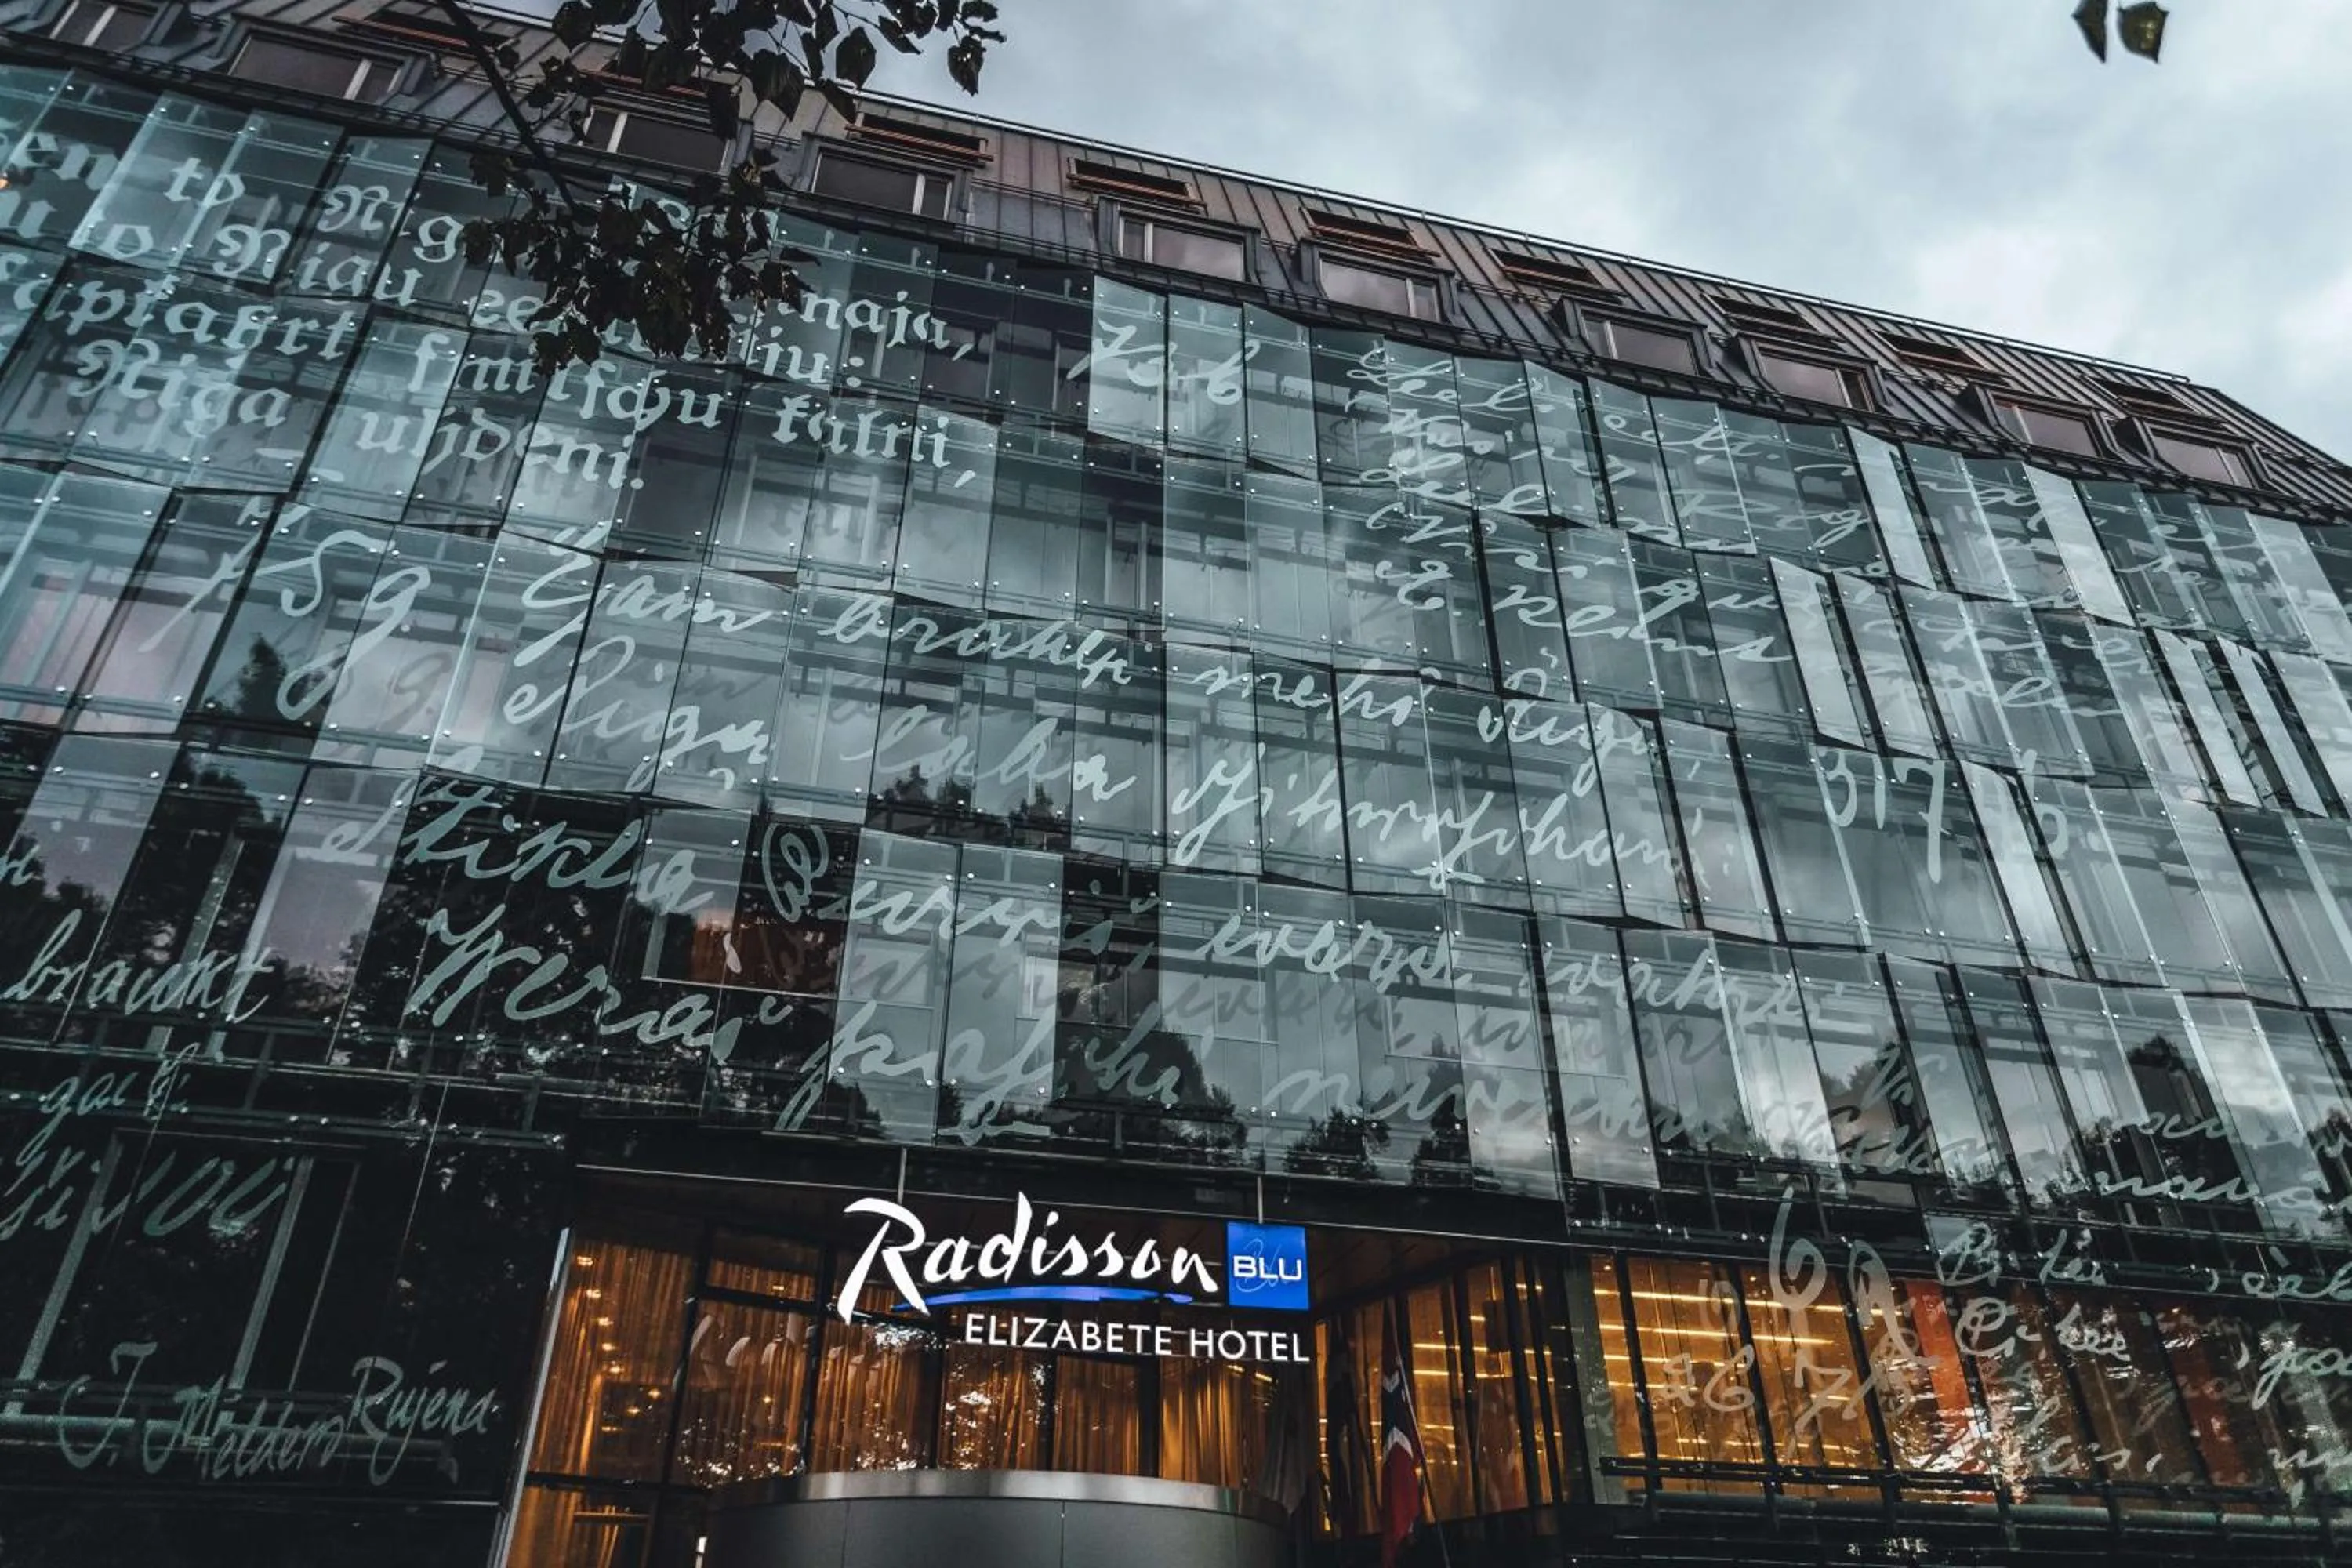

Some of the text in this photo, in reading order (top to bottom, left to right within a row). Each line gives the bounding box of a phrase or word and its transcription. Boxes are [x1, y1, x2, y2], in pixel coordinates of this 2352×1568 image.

[837, 1190, 1303, 1325] Radisson BLU
[964, 1312, 1311, 1364] ELIZABETE HOTEL
